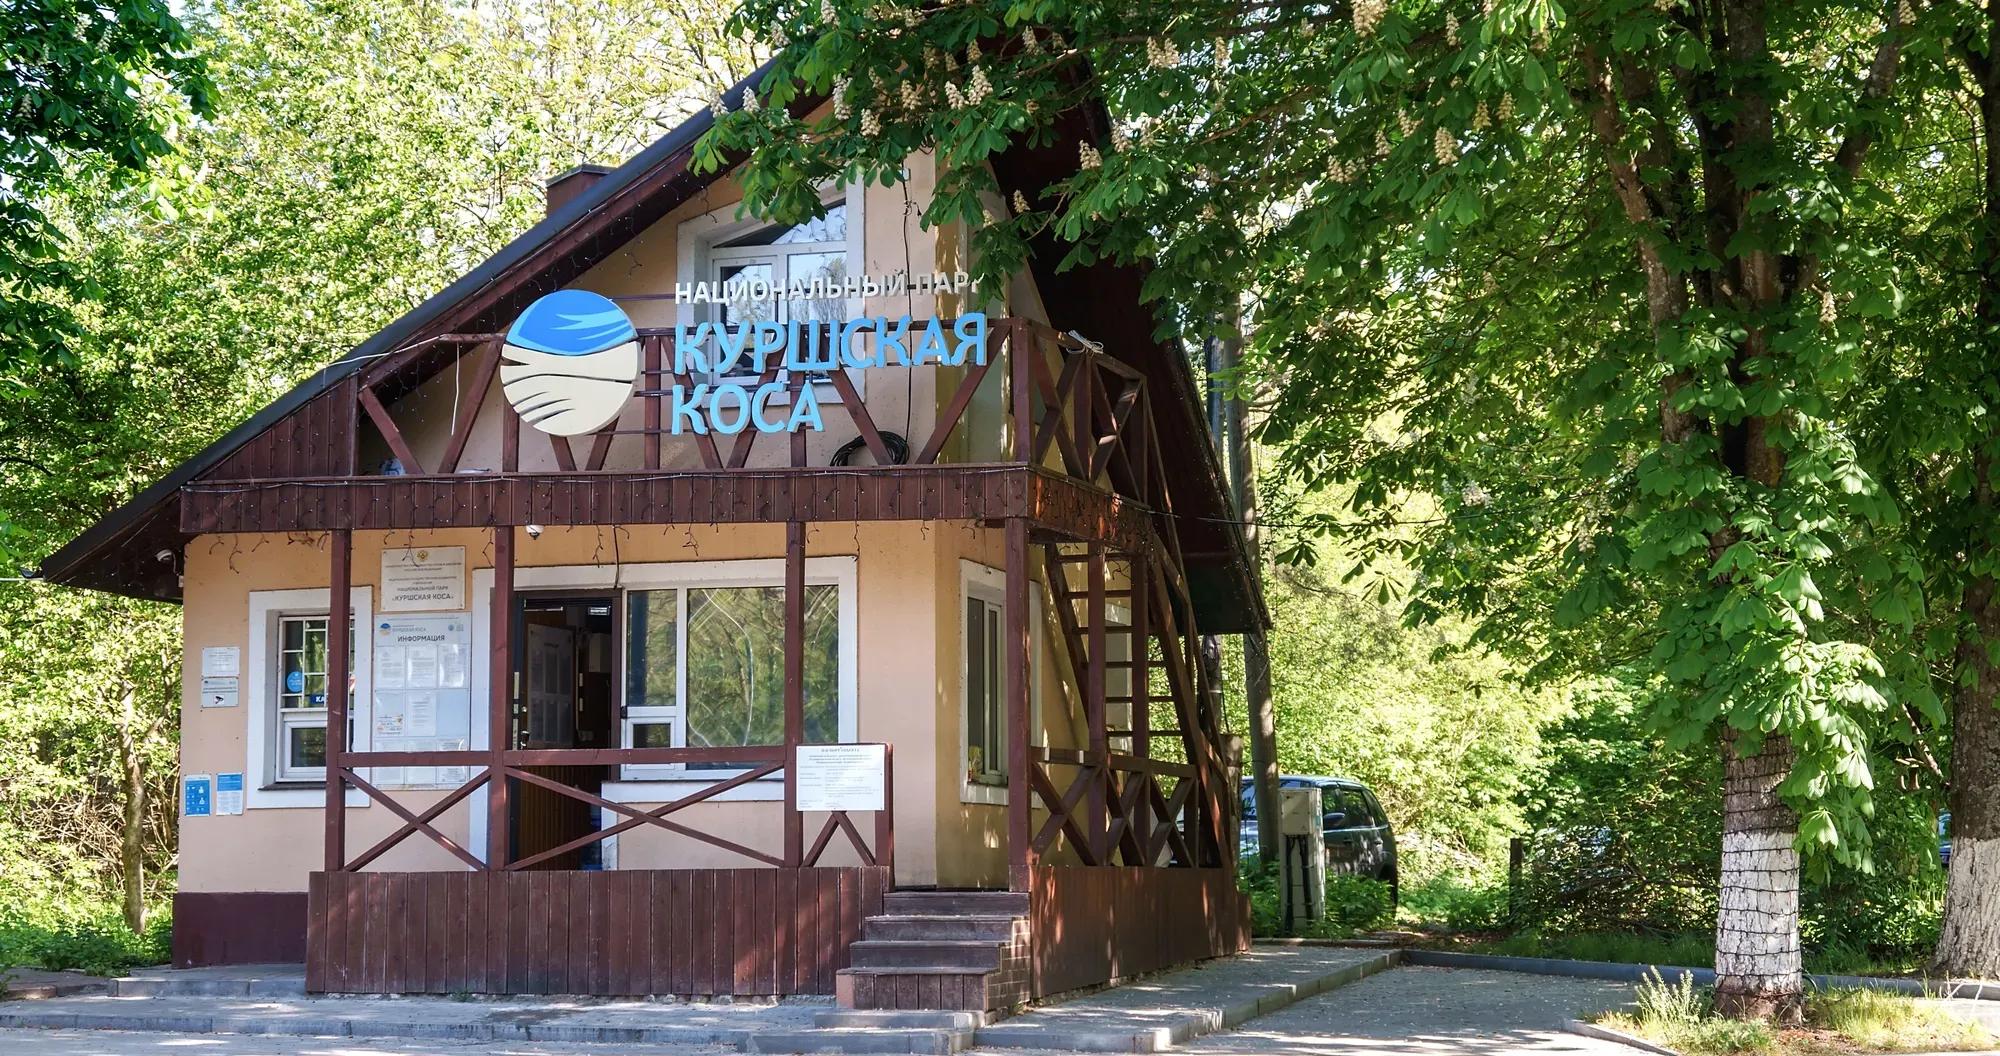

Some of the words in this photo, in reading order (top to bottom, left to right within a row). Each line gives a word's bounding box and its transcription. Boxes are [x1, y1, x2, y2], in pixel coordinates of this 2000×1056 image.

[675, 270, 908, 305] НАЦИОНАЛЬНЫЙ
[674, 312, 987, 375] КУРШСКАЯ
[671, 382, 824, 436] КОСА
[397, 634, 445, 642] ИНФОРМАЦИЯ
